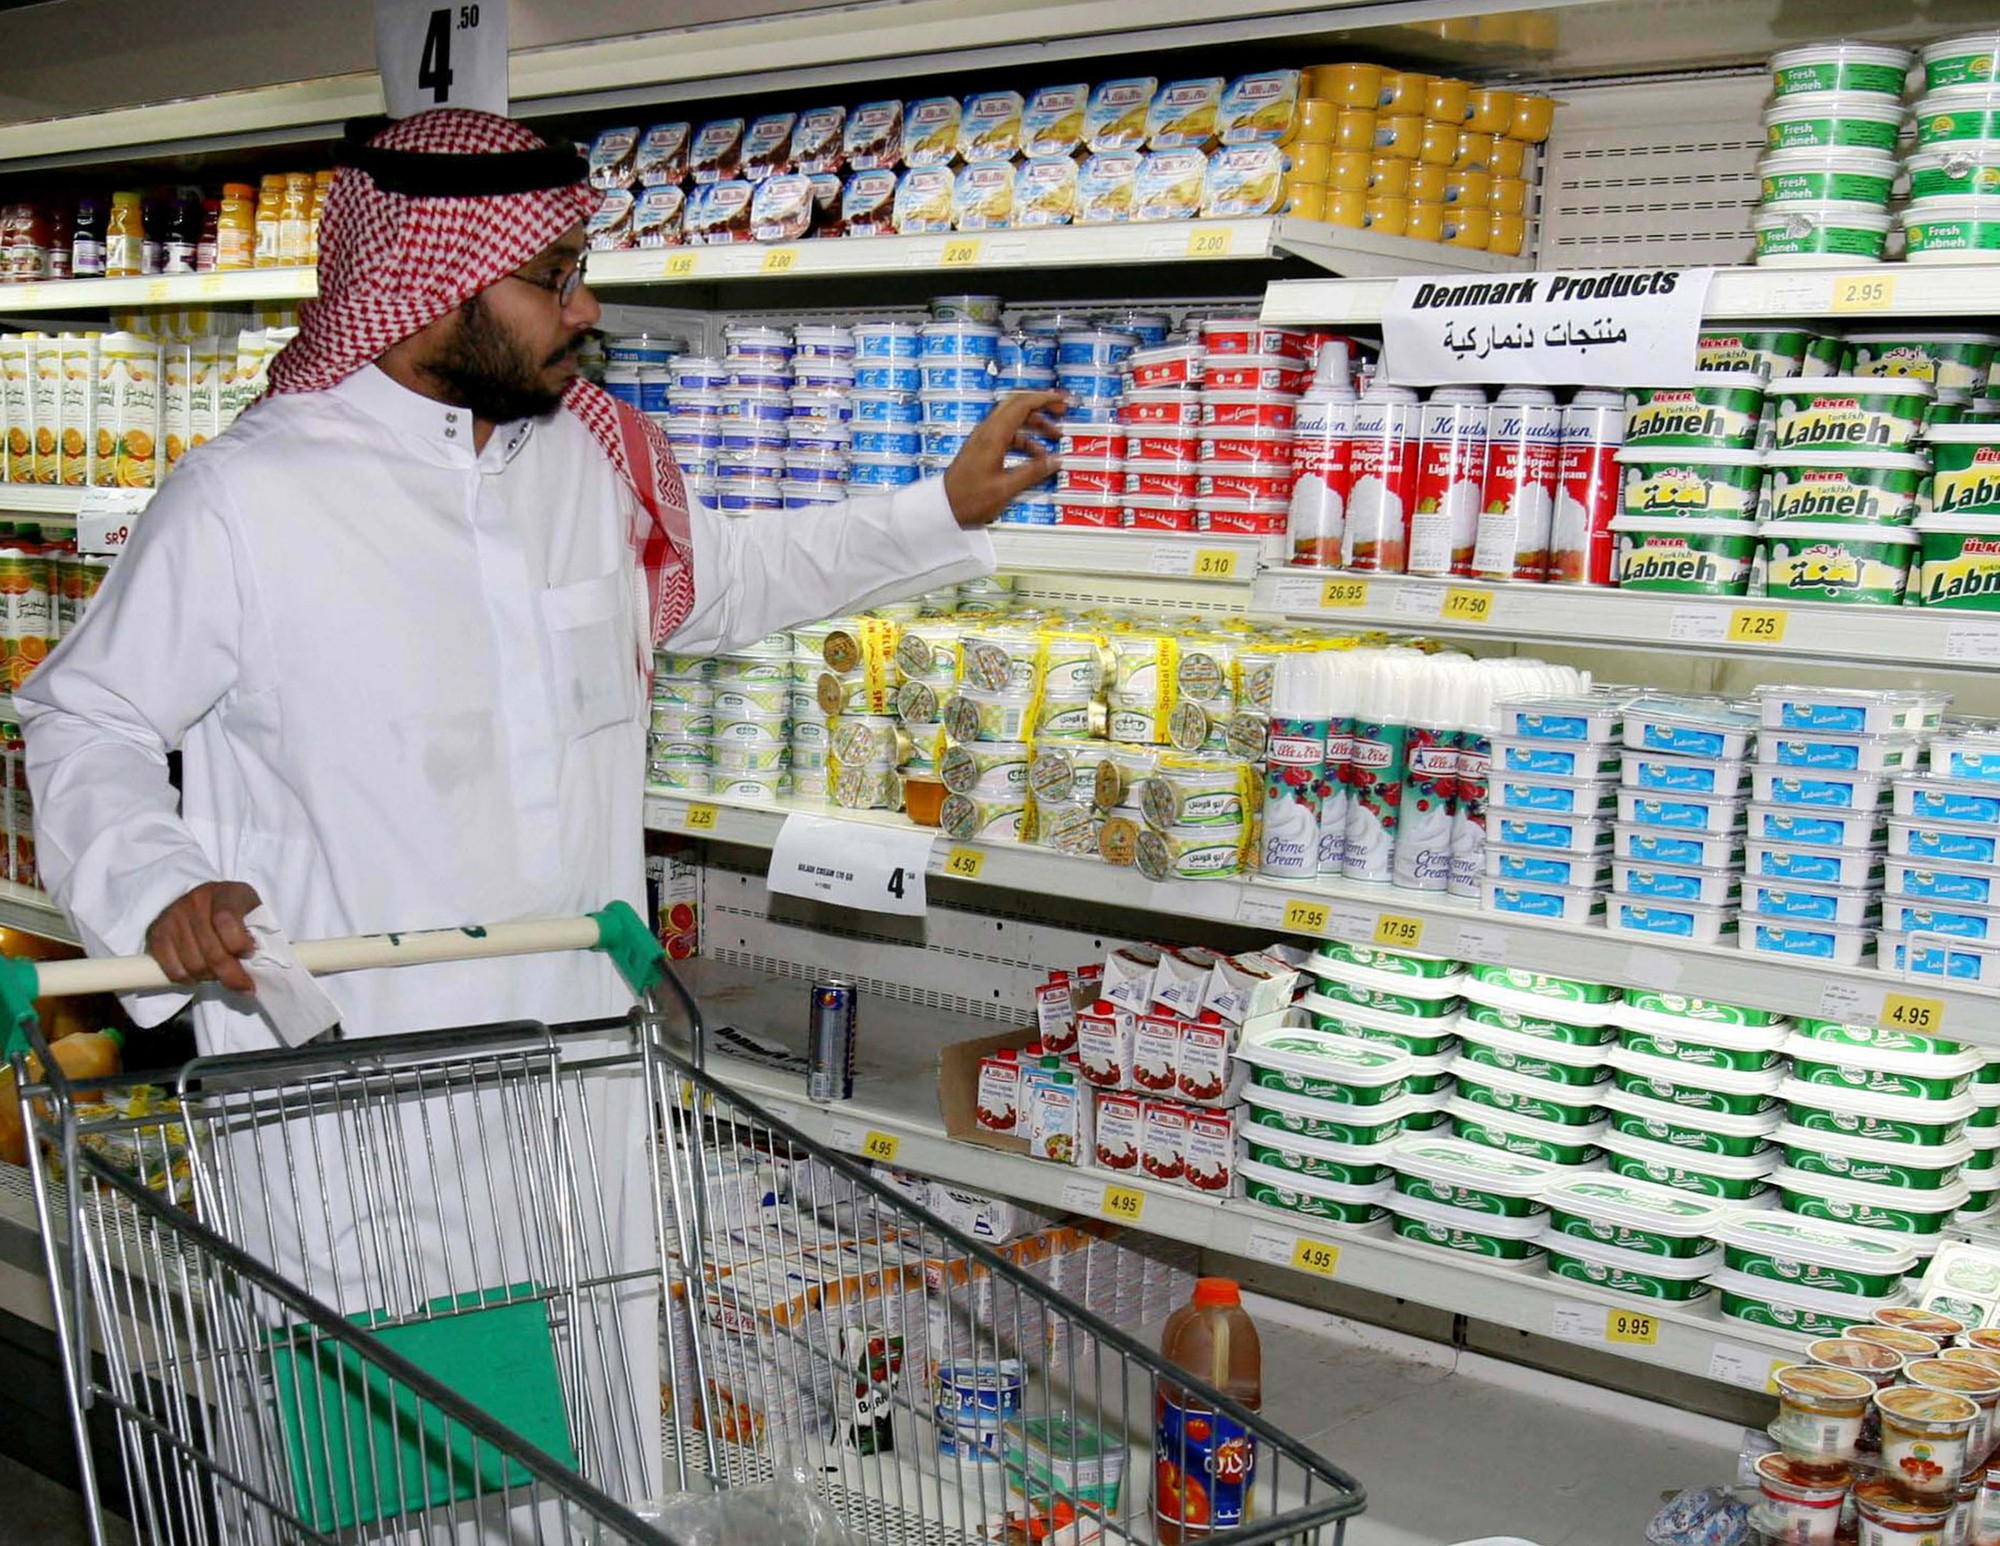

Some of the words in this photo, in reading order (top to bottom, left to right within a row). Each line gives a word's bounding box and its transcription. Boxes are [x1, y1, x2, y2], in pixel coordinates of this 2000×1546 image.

[419, 9, 453, 103] 4
[457, 5, 479, 29] .50
[1787, 67, 1816, 80] Fresh
[1784, 79, 1822, 92] Labneh
[1783, 123, 1812, 134] Fresh
[1780, 134, 1818, 146] Labneh
[1778, 177, 1807, 188] Fresh
[1774, 189, 1812, 199] Labneh
[1928, 225, 1960, 236] Fresh
[1196, 236, 1223, 250] 2.00
[1763, 241, 1799, 253] Labneh
[1924, 237, 1966, 249] Labneh
[947, 247, 972, 261] 2.00
[1411, 278, 1538, 309] Denmark
[1545, 270, 1680, 302] Products
[1846, 284, 1883, 302] 2.95
[1443, 321, 1534, 360] دنماركية
[1544, 318, 1627, 354] منتجات
[1652, 391, 1694, 403] ÜLKER
[1813, 398, 1857, 409] ÜLKER
[1624, 409, 1725, 440] Labneh
[1781, 416, 1891, 447] Labneh
[1803, 471, 1846, 482] ÜLKER
[1643, 481, 1713, 515] لبنة
[1775, 489, 1880, 520] Labneh
[1646, 537, 1686, 548] ÜLKER
[1201, 558, 1229, 573] 3.10
[1622, 556, 1718, 582] Labneh
[1789, 557, 1866, 596] لبنة
[1328, 585, 1363, 600] 26.95
[1451, 597, 1486, 613] 17.50
[1740, 617, 1776, 634] 7.25
[690, 811, 710, 824] 2.25
[953, 857, 976, 873] 4.50
[1266, 851, 1304, 868] Cream
[887, 867, 904, 899] 4
[1290, 909, 1323, 926] 17.95
[1382, 921, 1417, 938] 17.95
[1892, 1005, 1931, 1026] 4.95
[870, 1142, 891, 1156] 4.95
[1111, 1196, 1137, 1211] 4.95
[1302, 1250, 1331, 1267] 4.95
[1617, 1317, 1650, 1335] 9.95
